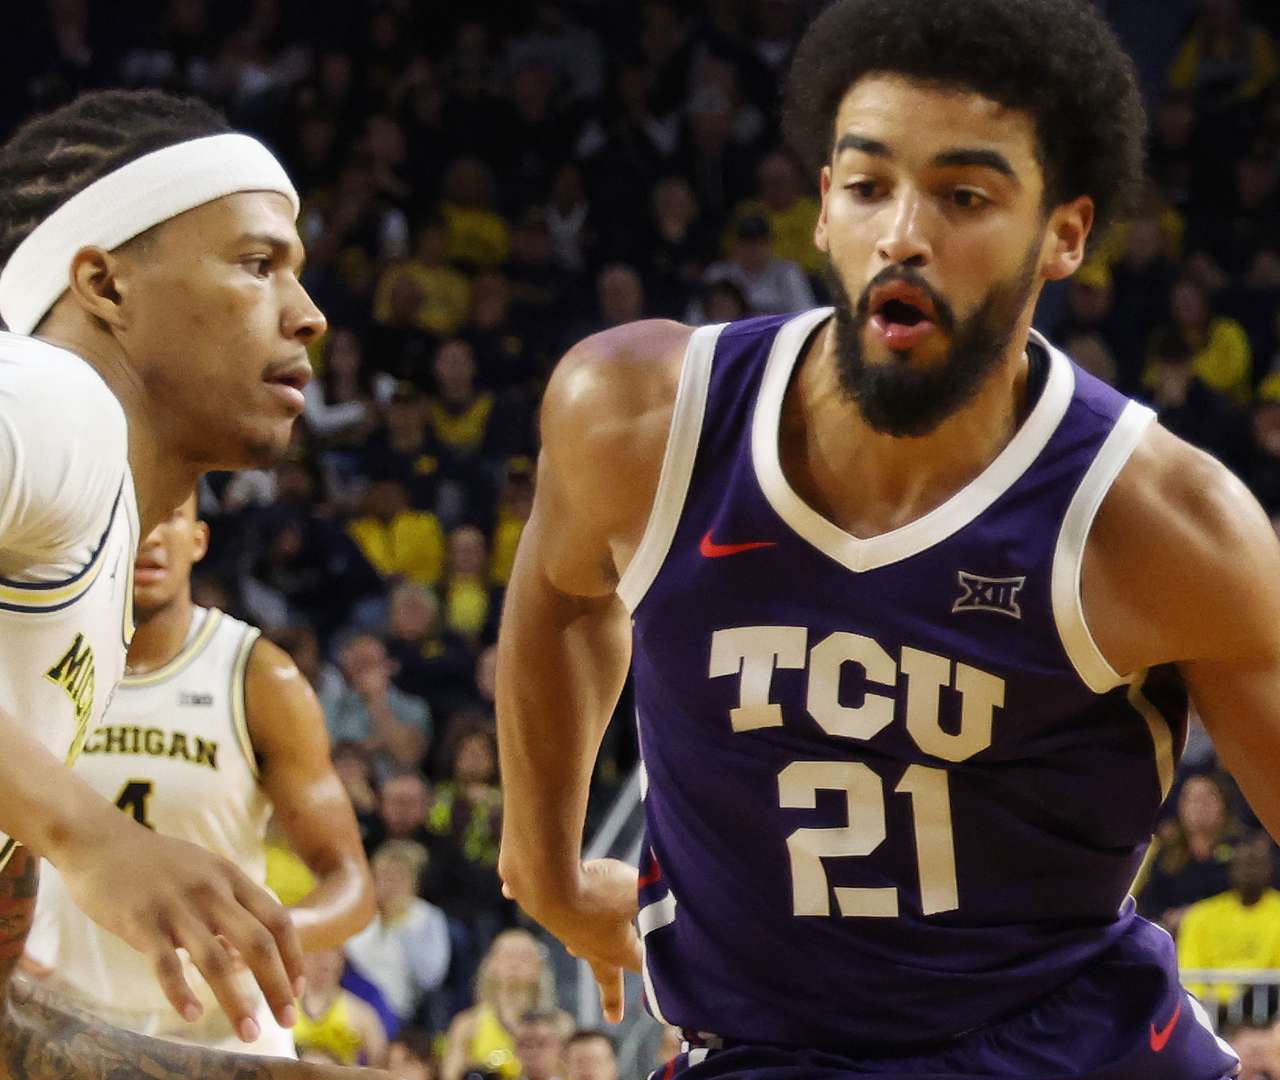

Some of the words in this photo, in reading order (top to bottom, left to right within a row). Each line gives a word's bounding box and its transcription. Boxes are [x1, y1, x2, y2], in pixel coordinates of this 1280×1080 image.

[82, 723, 220, 772] CHIGAN
[708, 625, 1006, 763] TCU
[776, 760, 960, 918] 21
